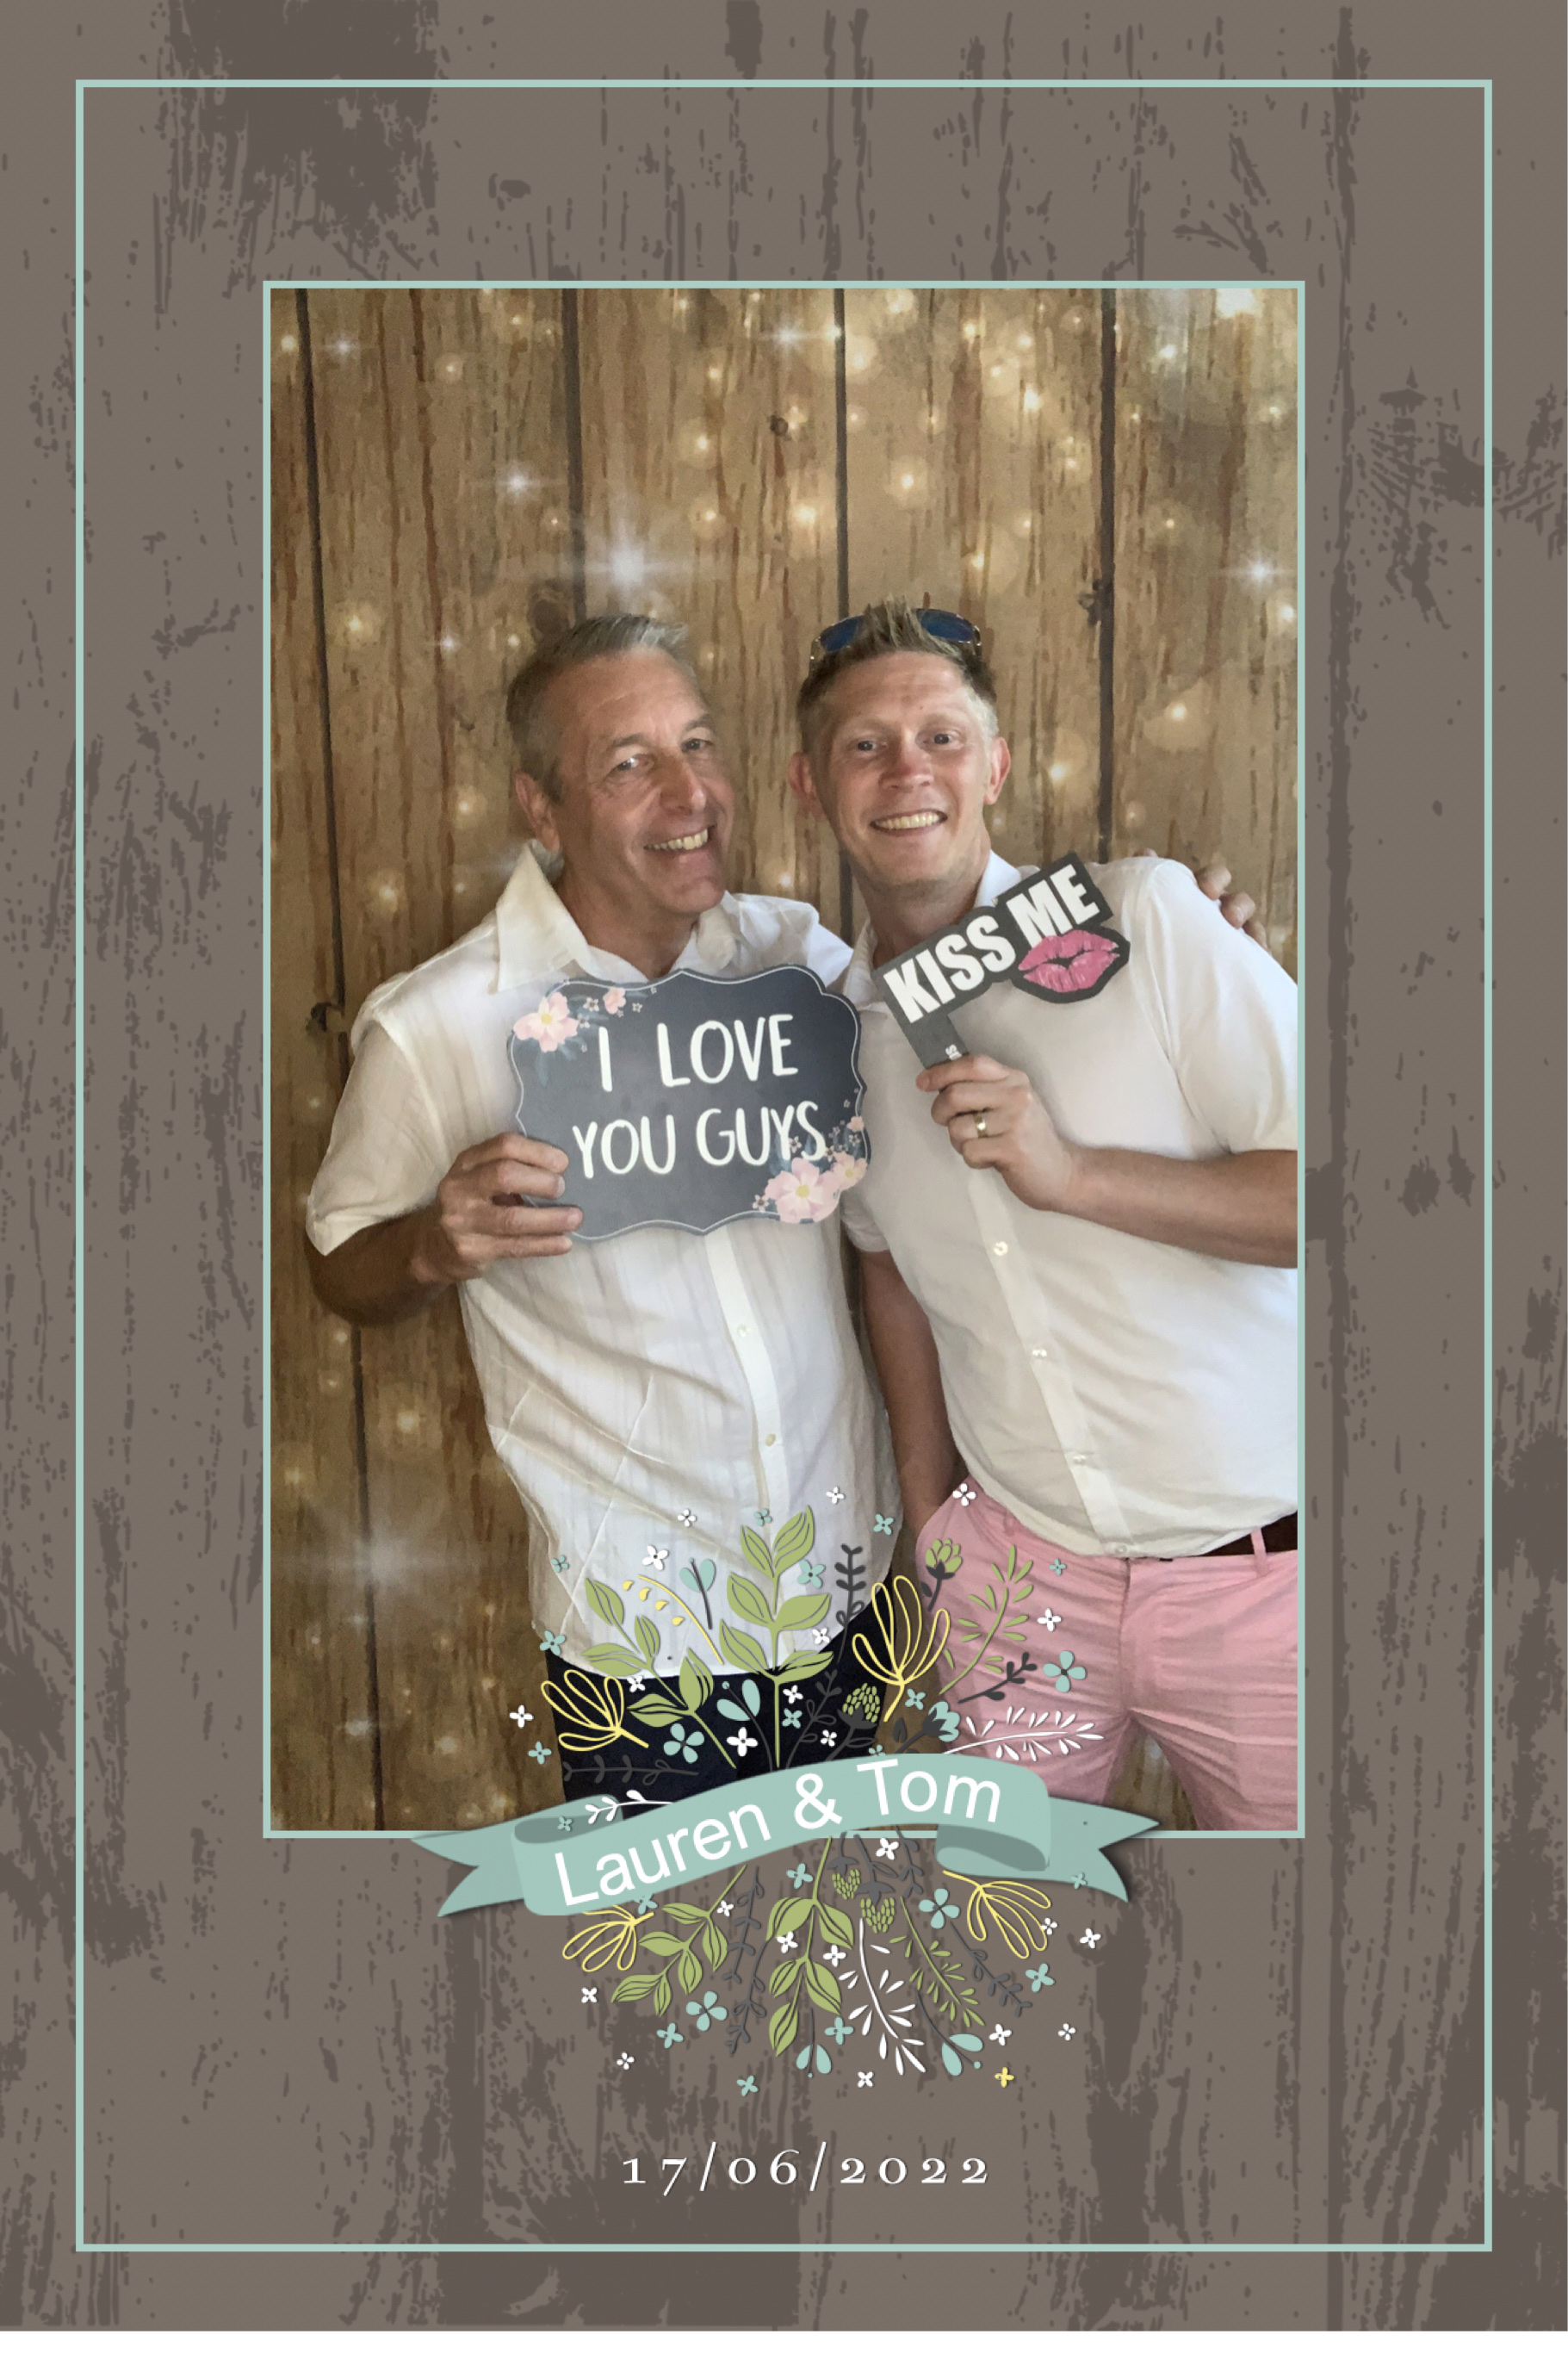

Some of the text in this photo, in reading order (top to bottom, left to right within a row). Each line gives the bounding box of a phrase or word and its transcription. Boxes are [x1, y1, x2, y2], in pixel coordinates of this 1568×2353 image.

[883, 865, 1100, 1023] KISS ME
[598, 1014, 798, 1092] I LOVE
[572, 1100, 826, 1179] YOU GUYS
